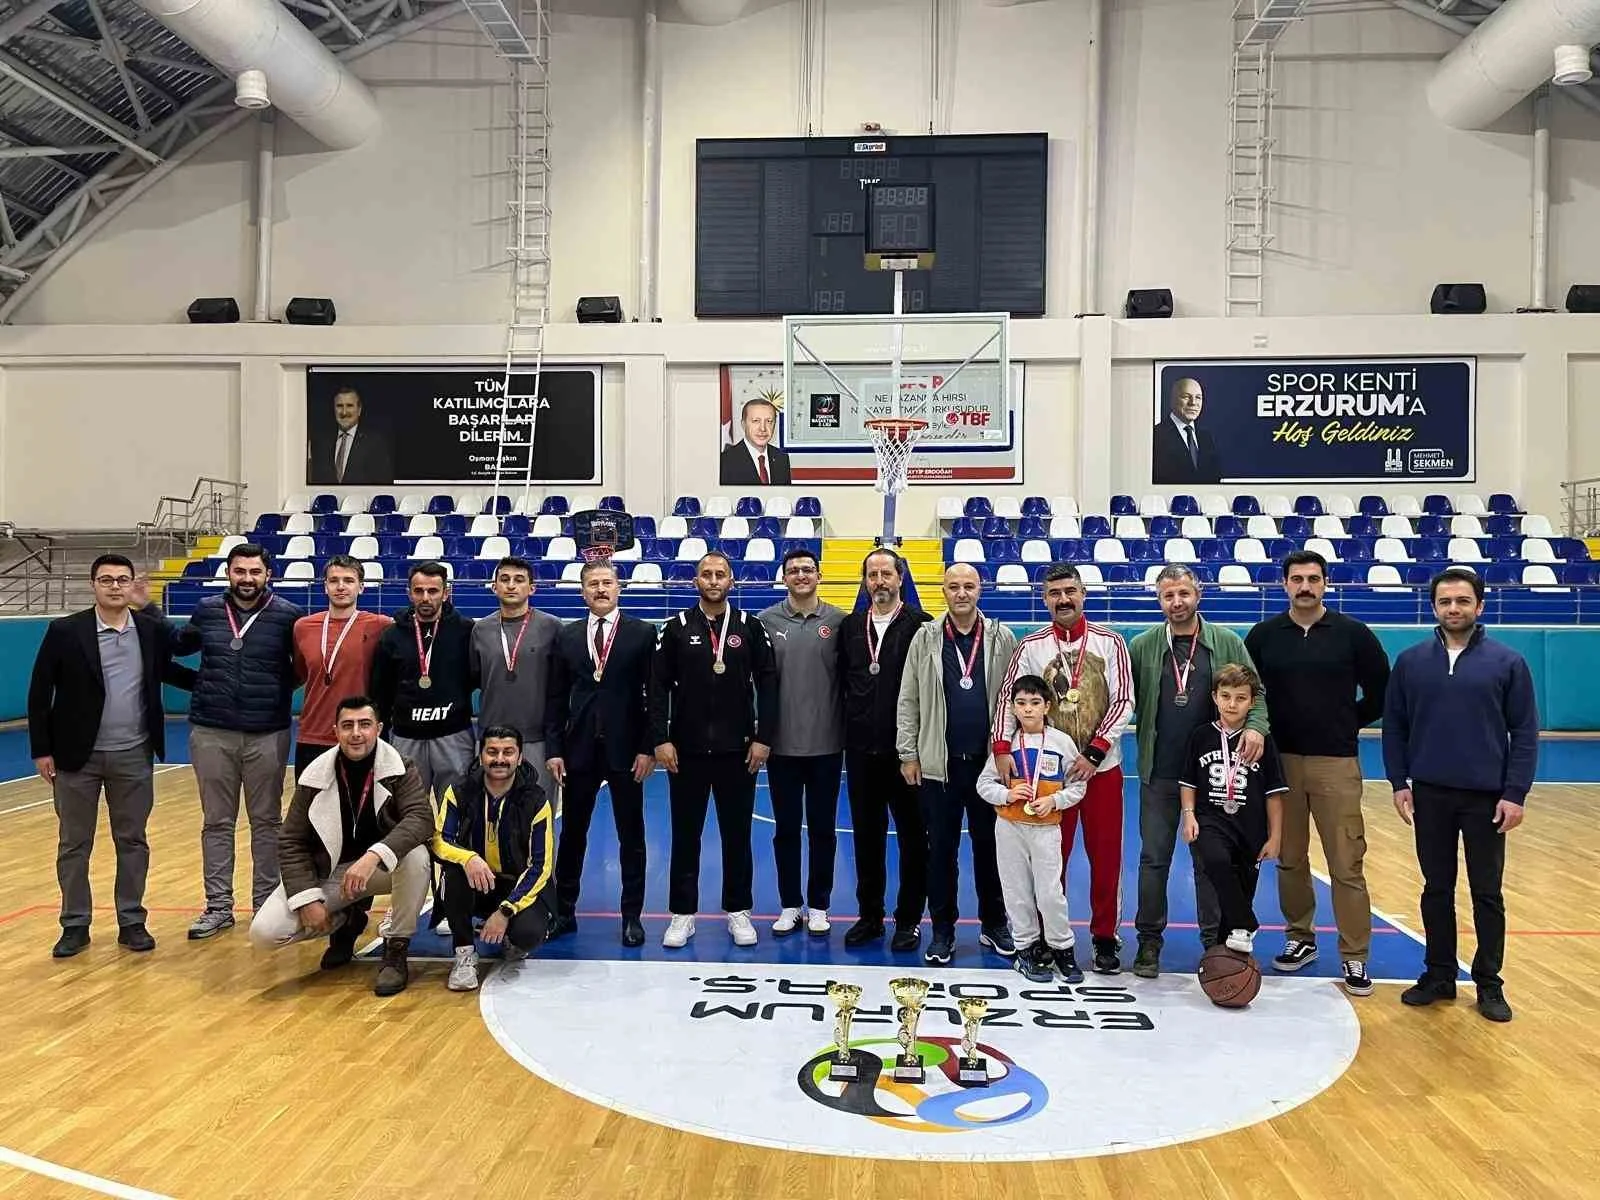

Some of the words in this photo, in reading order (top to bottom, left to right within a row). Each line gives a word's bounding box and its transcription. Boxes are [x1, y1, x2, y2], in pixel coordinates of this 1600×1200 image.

[475, 378, 508, 393] TÜM
[1267, 373, 1336, 393] SPOR
[1344, 368, 1417, 391] KENTİ
[433, 397, 551, 409] KATILIMCILARA
[875, 394, 889, 402] NE
[1256, 393, 1427, 417] ERZURUM'A
[448, 414, 535, 428] BAŞARLAR
[959, 412, 991, 426] TBF
[459, 428, 525, 442] DİLERİM.
[1272, 421, 1314, 447] Hoş
[1321, 420, 1415, 445] Geldiniz
[1413, 459, 1454, 468] SEKMEN
[412, 702, 453, 721] HEAT
[689, 1000, 1155, 1031] ERZURUM
